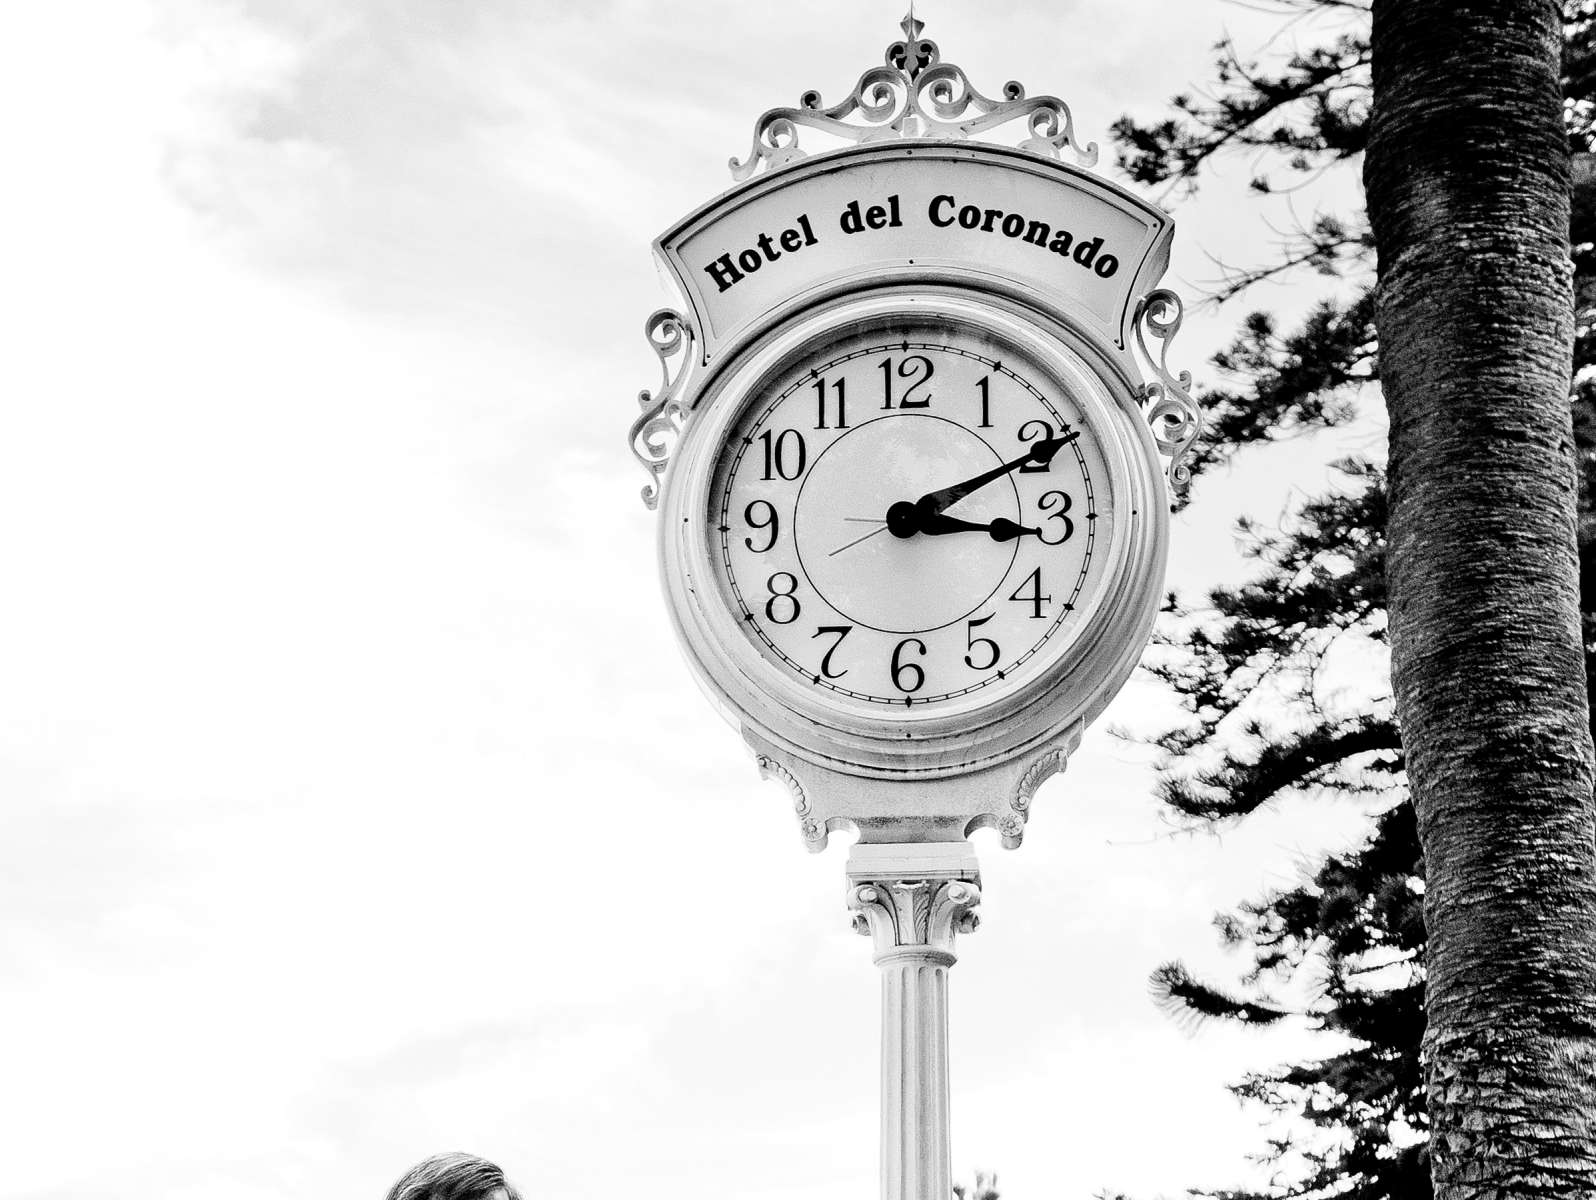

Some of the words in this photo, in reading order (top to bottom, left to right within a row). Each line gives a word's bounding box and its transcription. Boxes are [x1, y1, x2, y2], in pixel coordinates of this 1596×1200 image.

[704, 214, 818, 292] Hotel
[841, 195, 903, 234] del
[929, 195, 1119, 279] Coronado
[812, 377, 852, 430] 11
[878, 356, 935, 410] 12
[975, 375, 994, 429] 1
[758, 429, 807, 481] 10
[1017, 419, 1054, 474] 2
[744, 500, 779, 554] 9
[1036, 490, 1075, 546] 3
[766, 572, 801, 625] 8
[1009, 567, 1052, 619] 4
[812, 626, 853, 679] 7
[891, 639, 927, 693] 6
[964, 613, 1001, 671] 5
